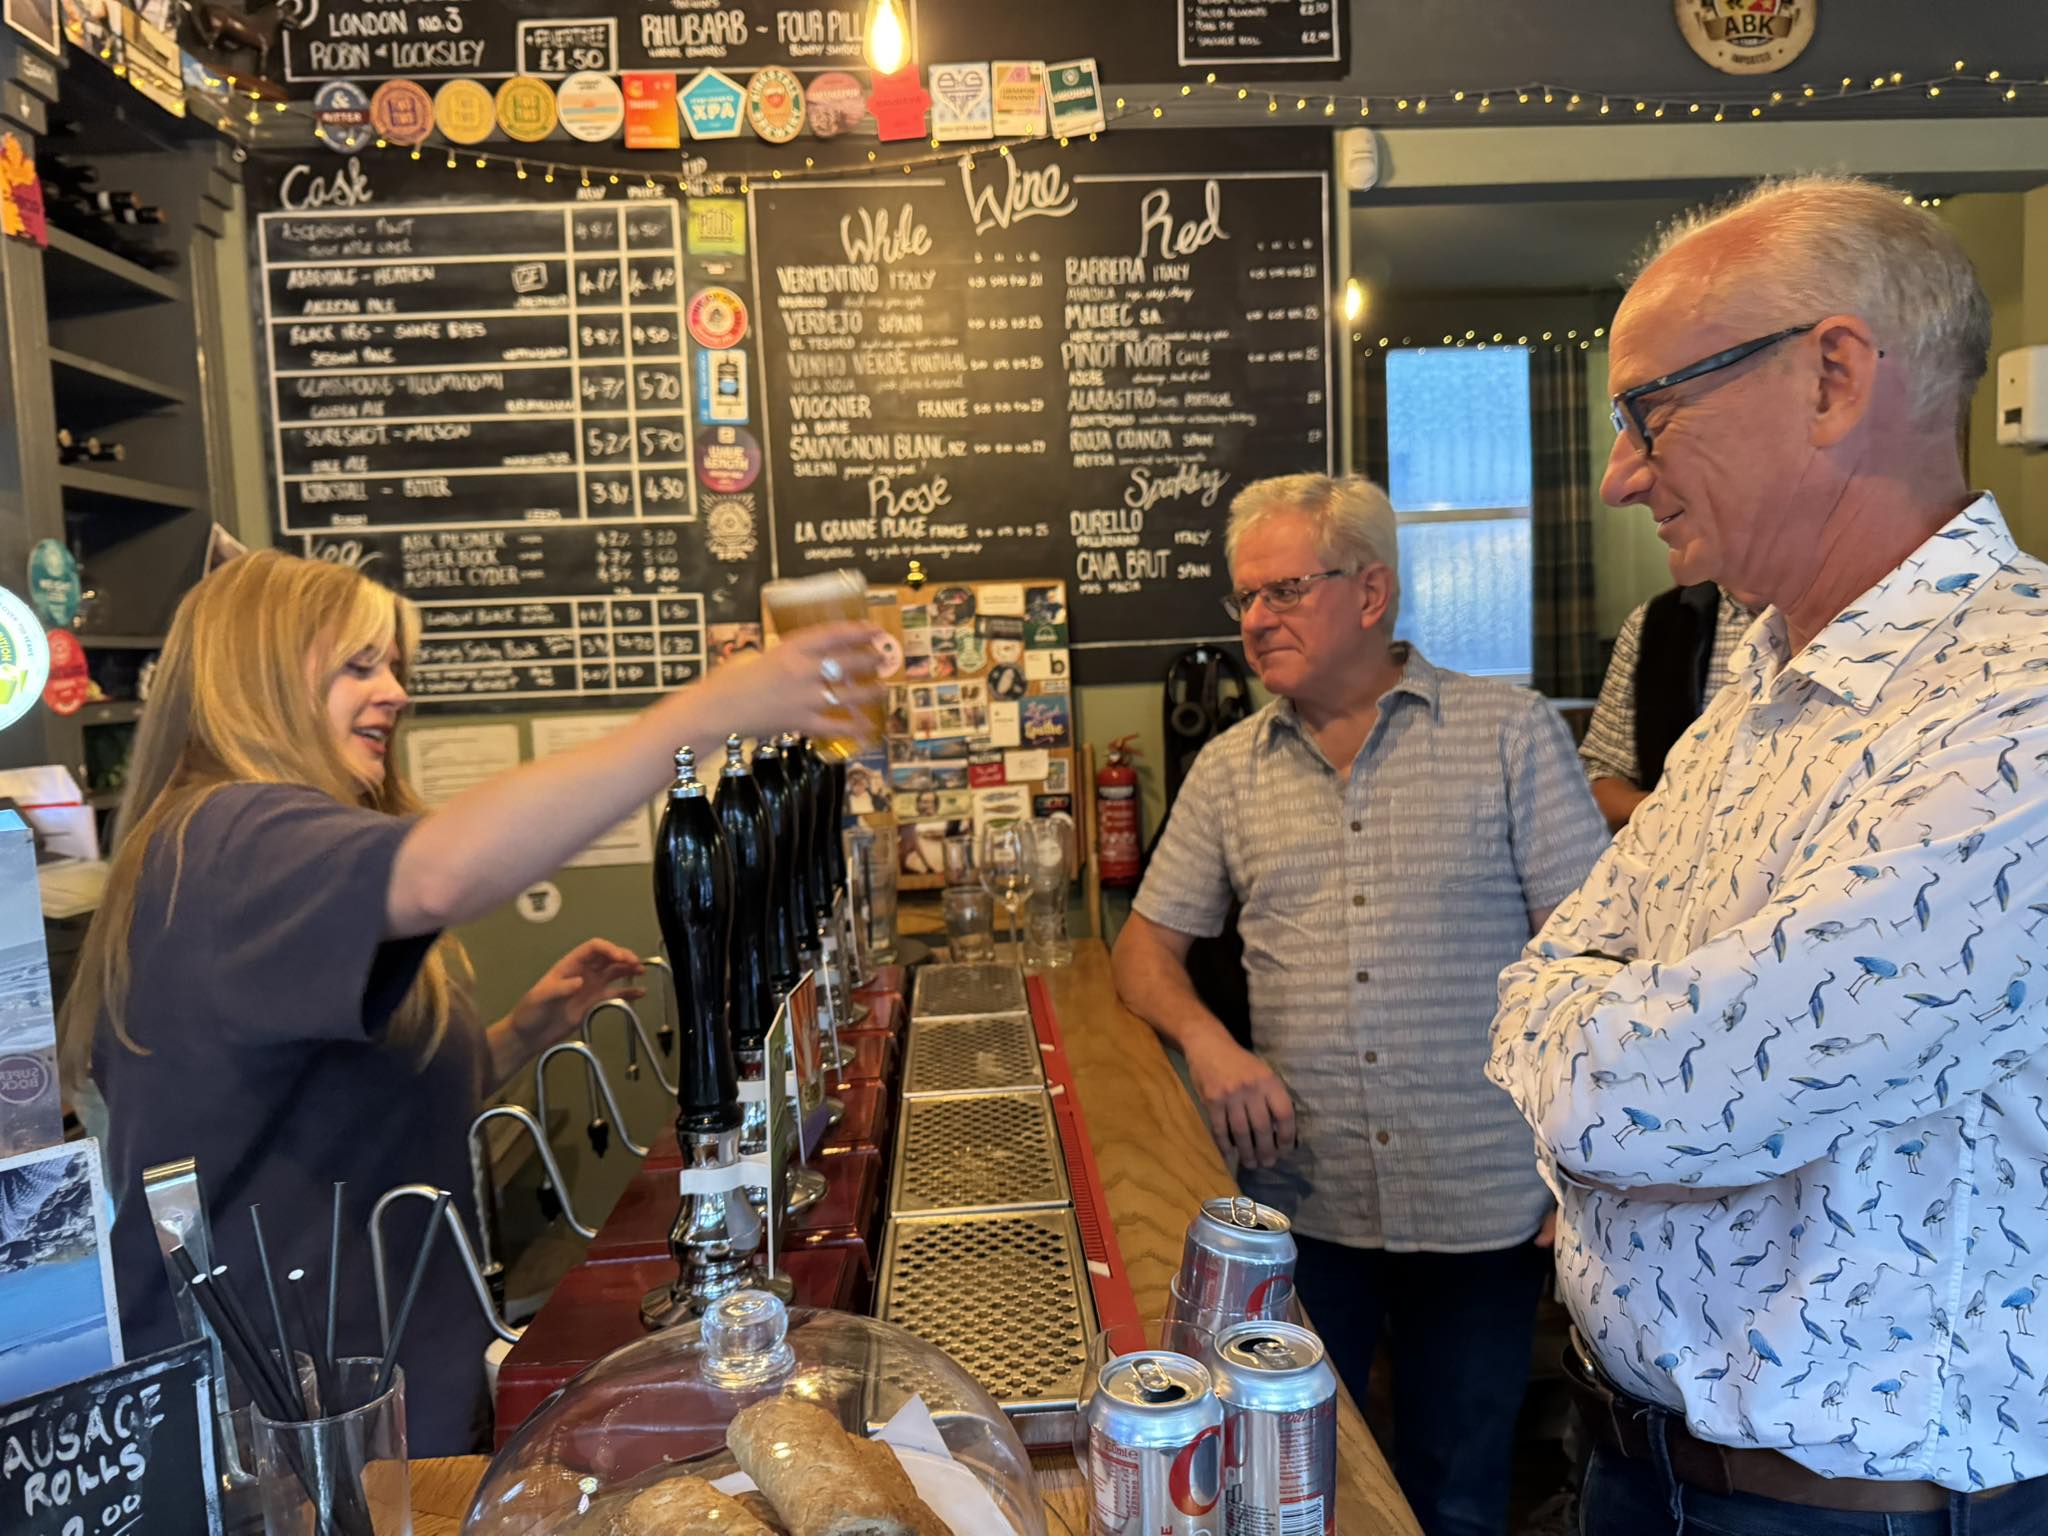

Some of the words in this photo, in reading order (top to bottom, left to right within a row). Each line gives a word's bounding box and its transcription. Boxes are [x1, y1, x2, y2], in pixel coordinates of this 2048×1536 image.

[329, 9, 408, 37] LONDON
[641, 9, 748, 47] RHUBARB
[777, 10, 824, 43] FOUR
[1725, 14, 1774, 36] ABK
[310, 40, 371, 70] ROBIN
[392, 40, 485, 68] LOCKSLEY
[692, 103, 736, 121] XPA
[280, 157, 373, 210] Cask
[958, 152, 1070, 229] Wine
[1139, 179, 1231, 259] Red
[776, 264, 879, 293] VERMENTINO
[1065, 256, 1145, 285] BARBERA
[781, 309, 864, 335] VERDEJO
[1065, 303, 1134, 329] MALBEC
[1060, 339, 1119, 370] PINOT
[789, 395, 872, 419] VIOGNIER
[789, 434, 891, 461] SAUVIGNON
[893, 433, 947, 460] BLANC
[1070, 509, 1143, 537] DURELLO
[1076, 551, 1122, 580] CAVA
[1126, 550, 1172, 579] BRUT
[24, 1442, 146, 1517] ROLLS
